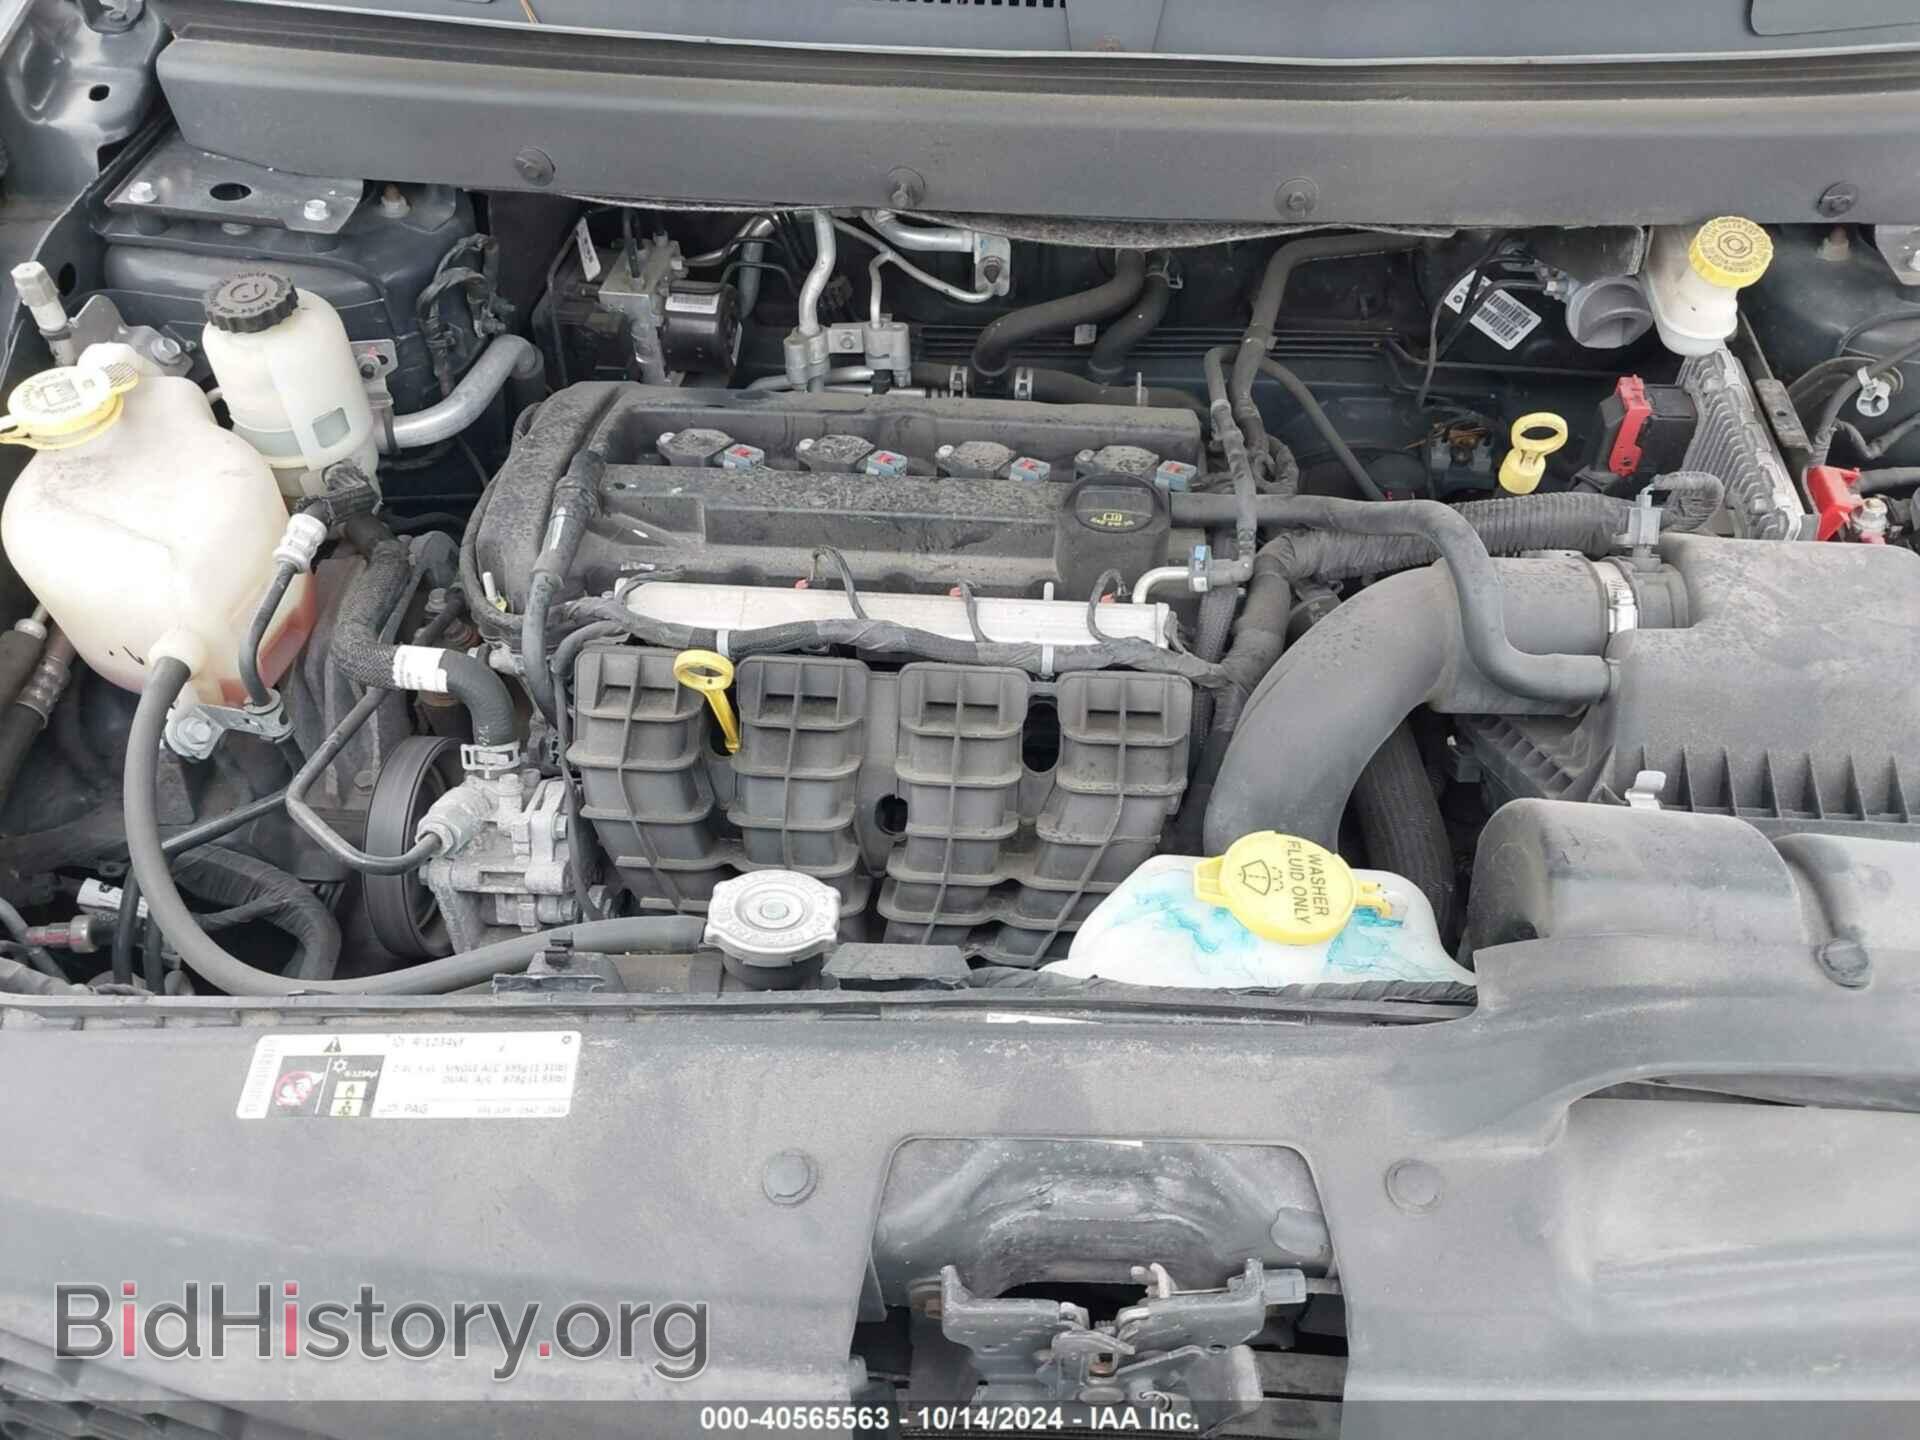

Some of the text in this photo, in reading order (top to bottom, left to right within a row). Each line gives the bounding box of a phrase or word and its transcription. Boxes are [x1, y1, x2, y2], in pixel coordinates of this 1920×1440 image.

[1287, 840, 1312, 925] FLUID ONLY
[1308, 853, 1330, 917] WASHER
